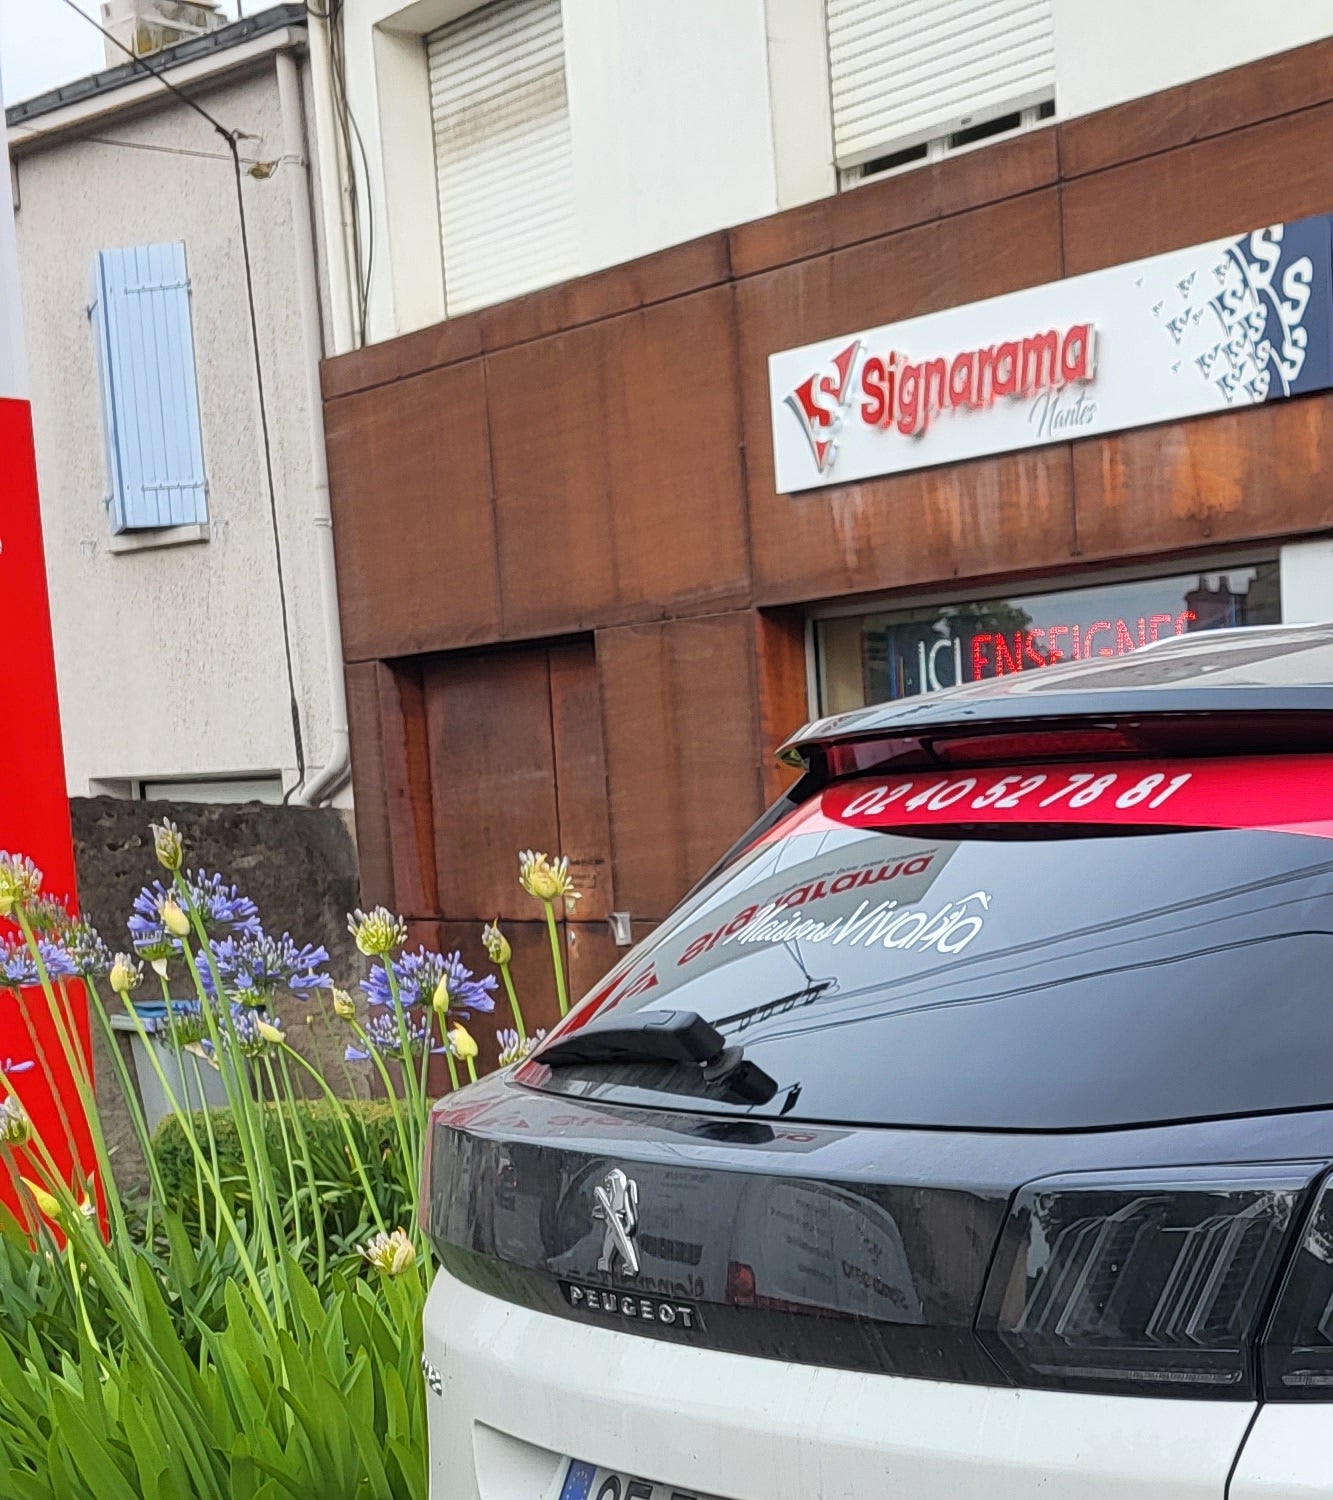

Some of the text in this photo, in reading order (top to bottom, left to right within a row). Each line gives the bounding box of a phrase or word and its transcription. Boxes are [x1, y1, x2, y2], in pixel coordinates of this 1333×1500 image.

[861, 322, 1094, 435] Signarama
[1027, 391, 1098, 438] Nantes
[918, 636, 963, 696] ICI
[840, 772, 1193, 819] 02 40 52 78 81
[569, 1285, 694, 1328] PEUGEOT
